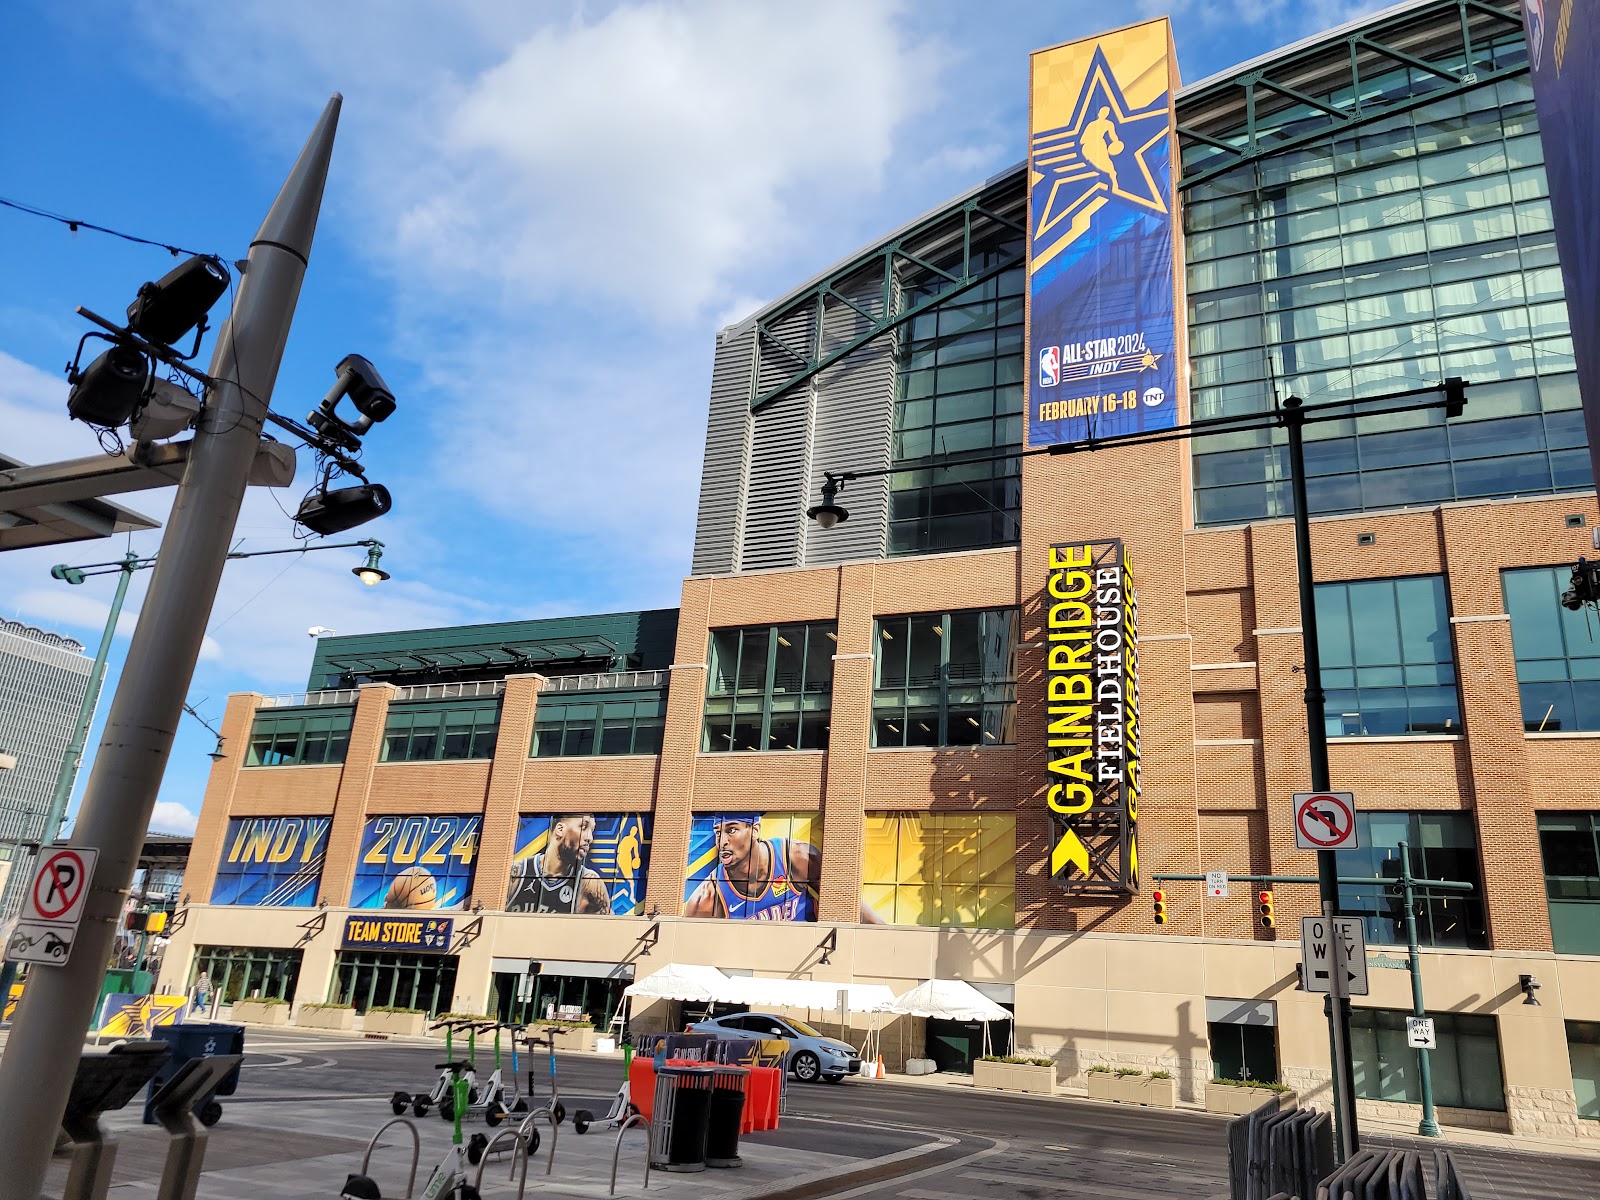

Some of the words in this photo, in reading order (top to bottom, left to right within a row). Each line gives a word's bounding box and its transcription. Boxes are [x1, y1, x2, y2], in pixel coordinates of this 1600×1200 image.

[1118, 332, 1145, 355] 2024
[1090, 360, 1120, 375] INDY
[1043, 377, 1053, 385] NBA
[1039, 396, 1100, 422] FEBRUARY
[1102, 390, 1137, 413] 16-18
[1144, 393, 1164, 402] TNT
[1048, 544, 1094, 814] GAINBRIDGE
[1097, 566, 1123, 783] FIELDHOUSE
[1123, 545, 1139, 821] GAINBRIDGE
[227, 817, 333, 863] INDY
[363, 816, 482, 864] 2024
[348, 920, 381, 942] TEAM
[381, 921, 424, 944] STORE
[1313, 922, 1354, 941] OE
[1312, 943, 1356, 961] WY
[1412, 1019, 1430, 1028] ONE
[1412, 1027, 1430, 1035] WAY
